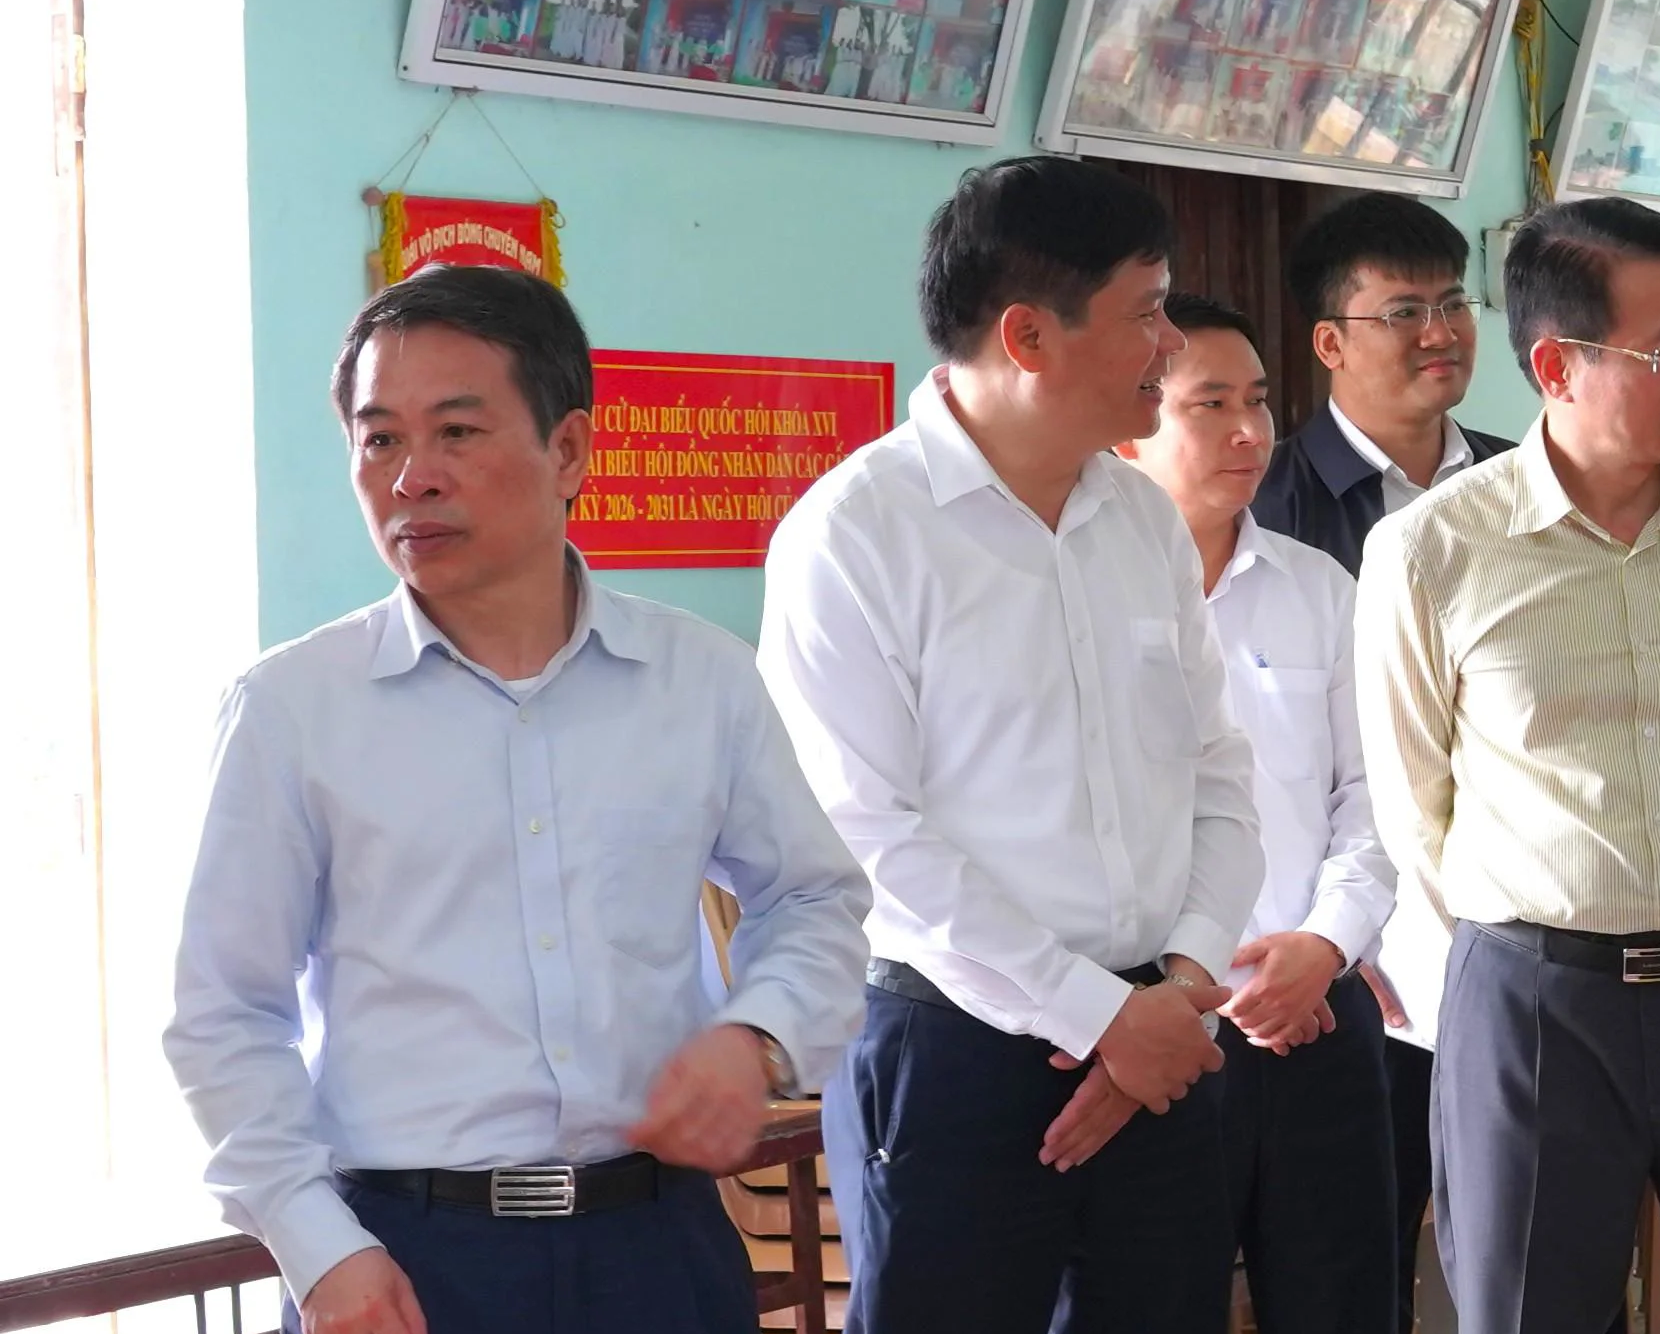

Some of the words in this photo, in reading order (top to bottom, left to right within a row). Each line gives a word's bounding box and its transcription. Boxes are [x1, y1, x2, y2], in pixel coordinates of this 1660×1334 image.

[629, 404, 657, 440] ĐẠI
[660, 393, 696, 434] BIỂU
[698, 395, 741, 440] QUỐC
[744, 401, 771, 442] HỘI
[773, 402, 811, 437] KHÓA
[812, 410, 838, 437] XVI
[585, 449, 603, 484] ẠI
[605, 436, 642, 477] BIỂU
[644, 442, 674, 485] HỘI
[676, 438, 719, 478] ĐỒNG
[721, 444, 765, 478] NHÂN
[766, 444, 793, 478] DÂN
[795, 445, 823, 479] CÁC
[579, 485, 601, 521] KỲ
[604, 494, 635, 522] 2026
[646, 494, 675, 521] 2031
[678, 487, 699, 521] LÀ
[701, 486, 744, 521] NGÀY
[747, 486, 773, 527] HỘI
